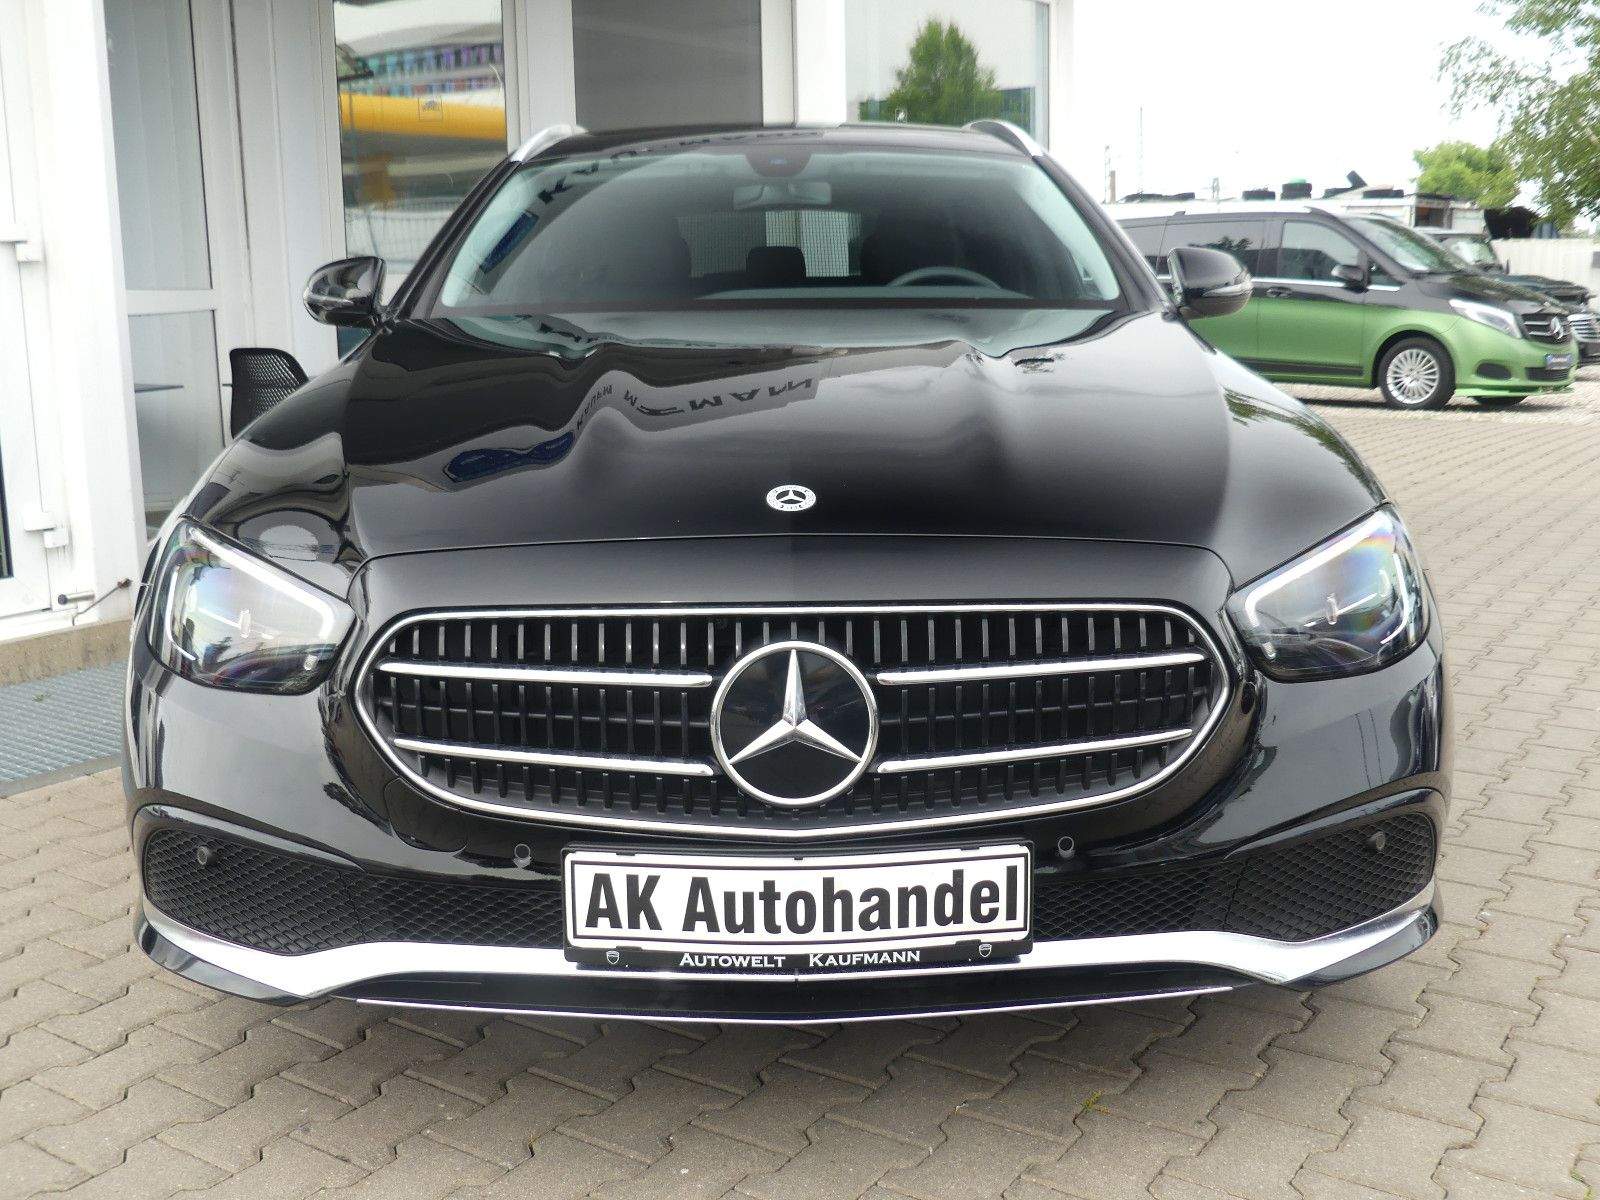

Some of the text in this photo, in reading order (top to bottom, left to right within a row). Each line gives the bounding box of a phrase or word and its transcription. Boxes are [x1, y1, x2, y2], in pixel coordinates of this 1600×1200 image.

[585, 864, 1019, 934] AK Autohandel
[679, 950, 921, 968] AUTOWELT KAUFMANN
